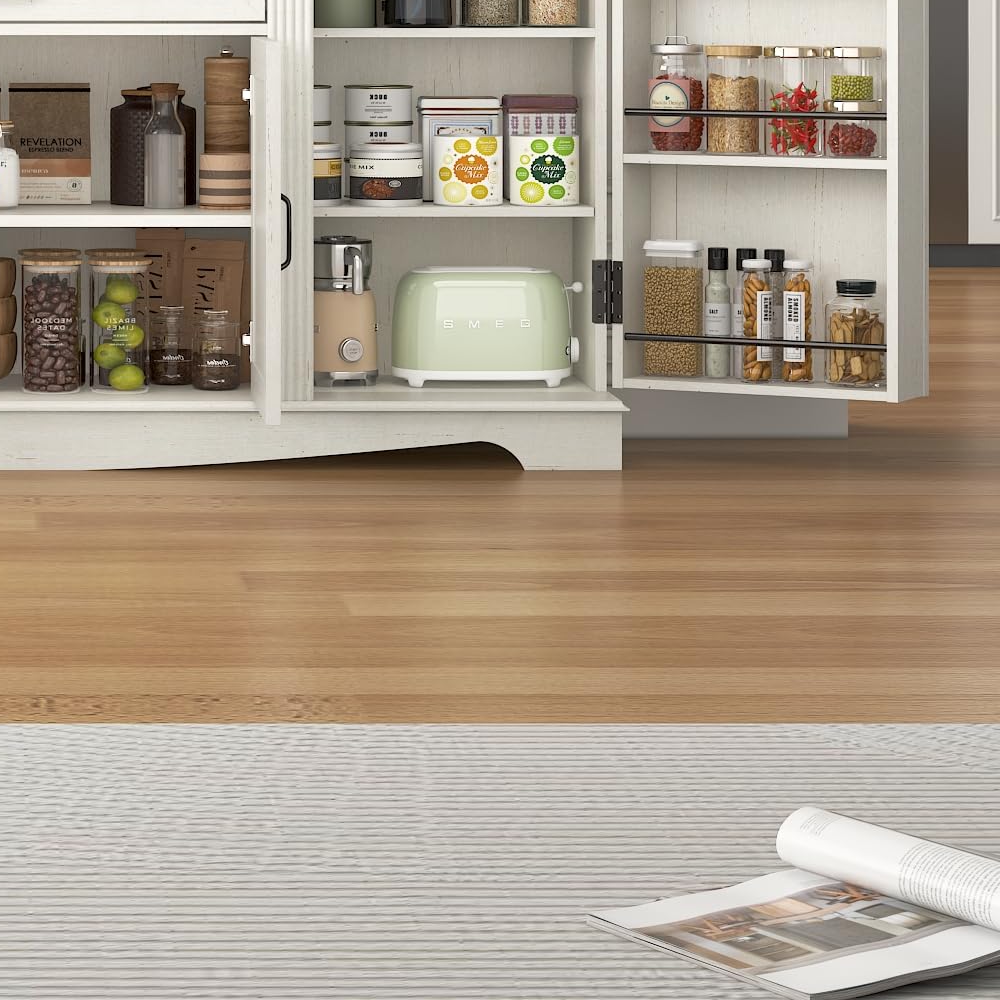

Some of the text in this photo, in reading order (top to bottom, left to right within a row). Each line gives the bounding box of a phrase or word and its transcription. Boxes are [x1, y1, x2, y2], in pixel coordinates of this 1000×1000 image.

[20, 137, 82, 147] REVELATION
[455, 163, 487, 172] Cupcake
[532, 163, 564, 172] Cupcake
[443, 319, 531, 329] SMEG
